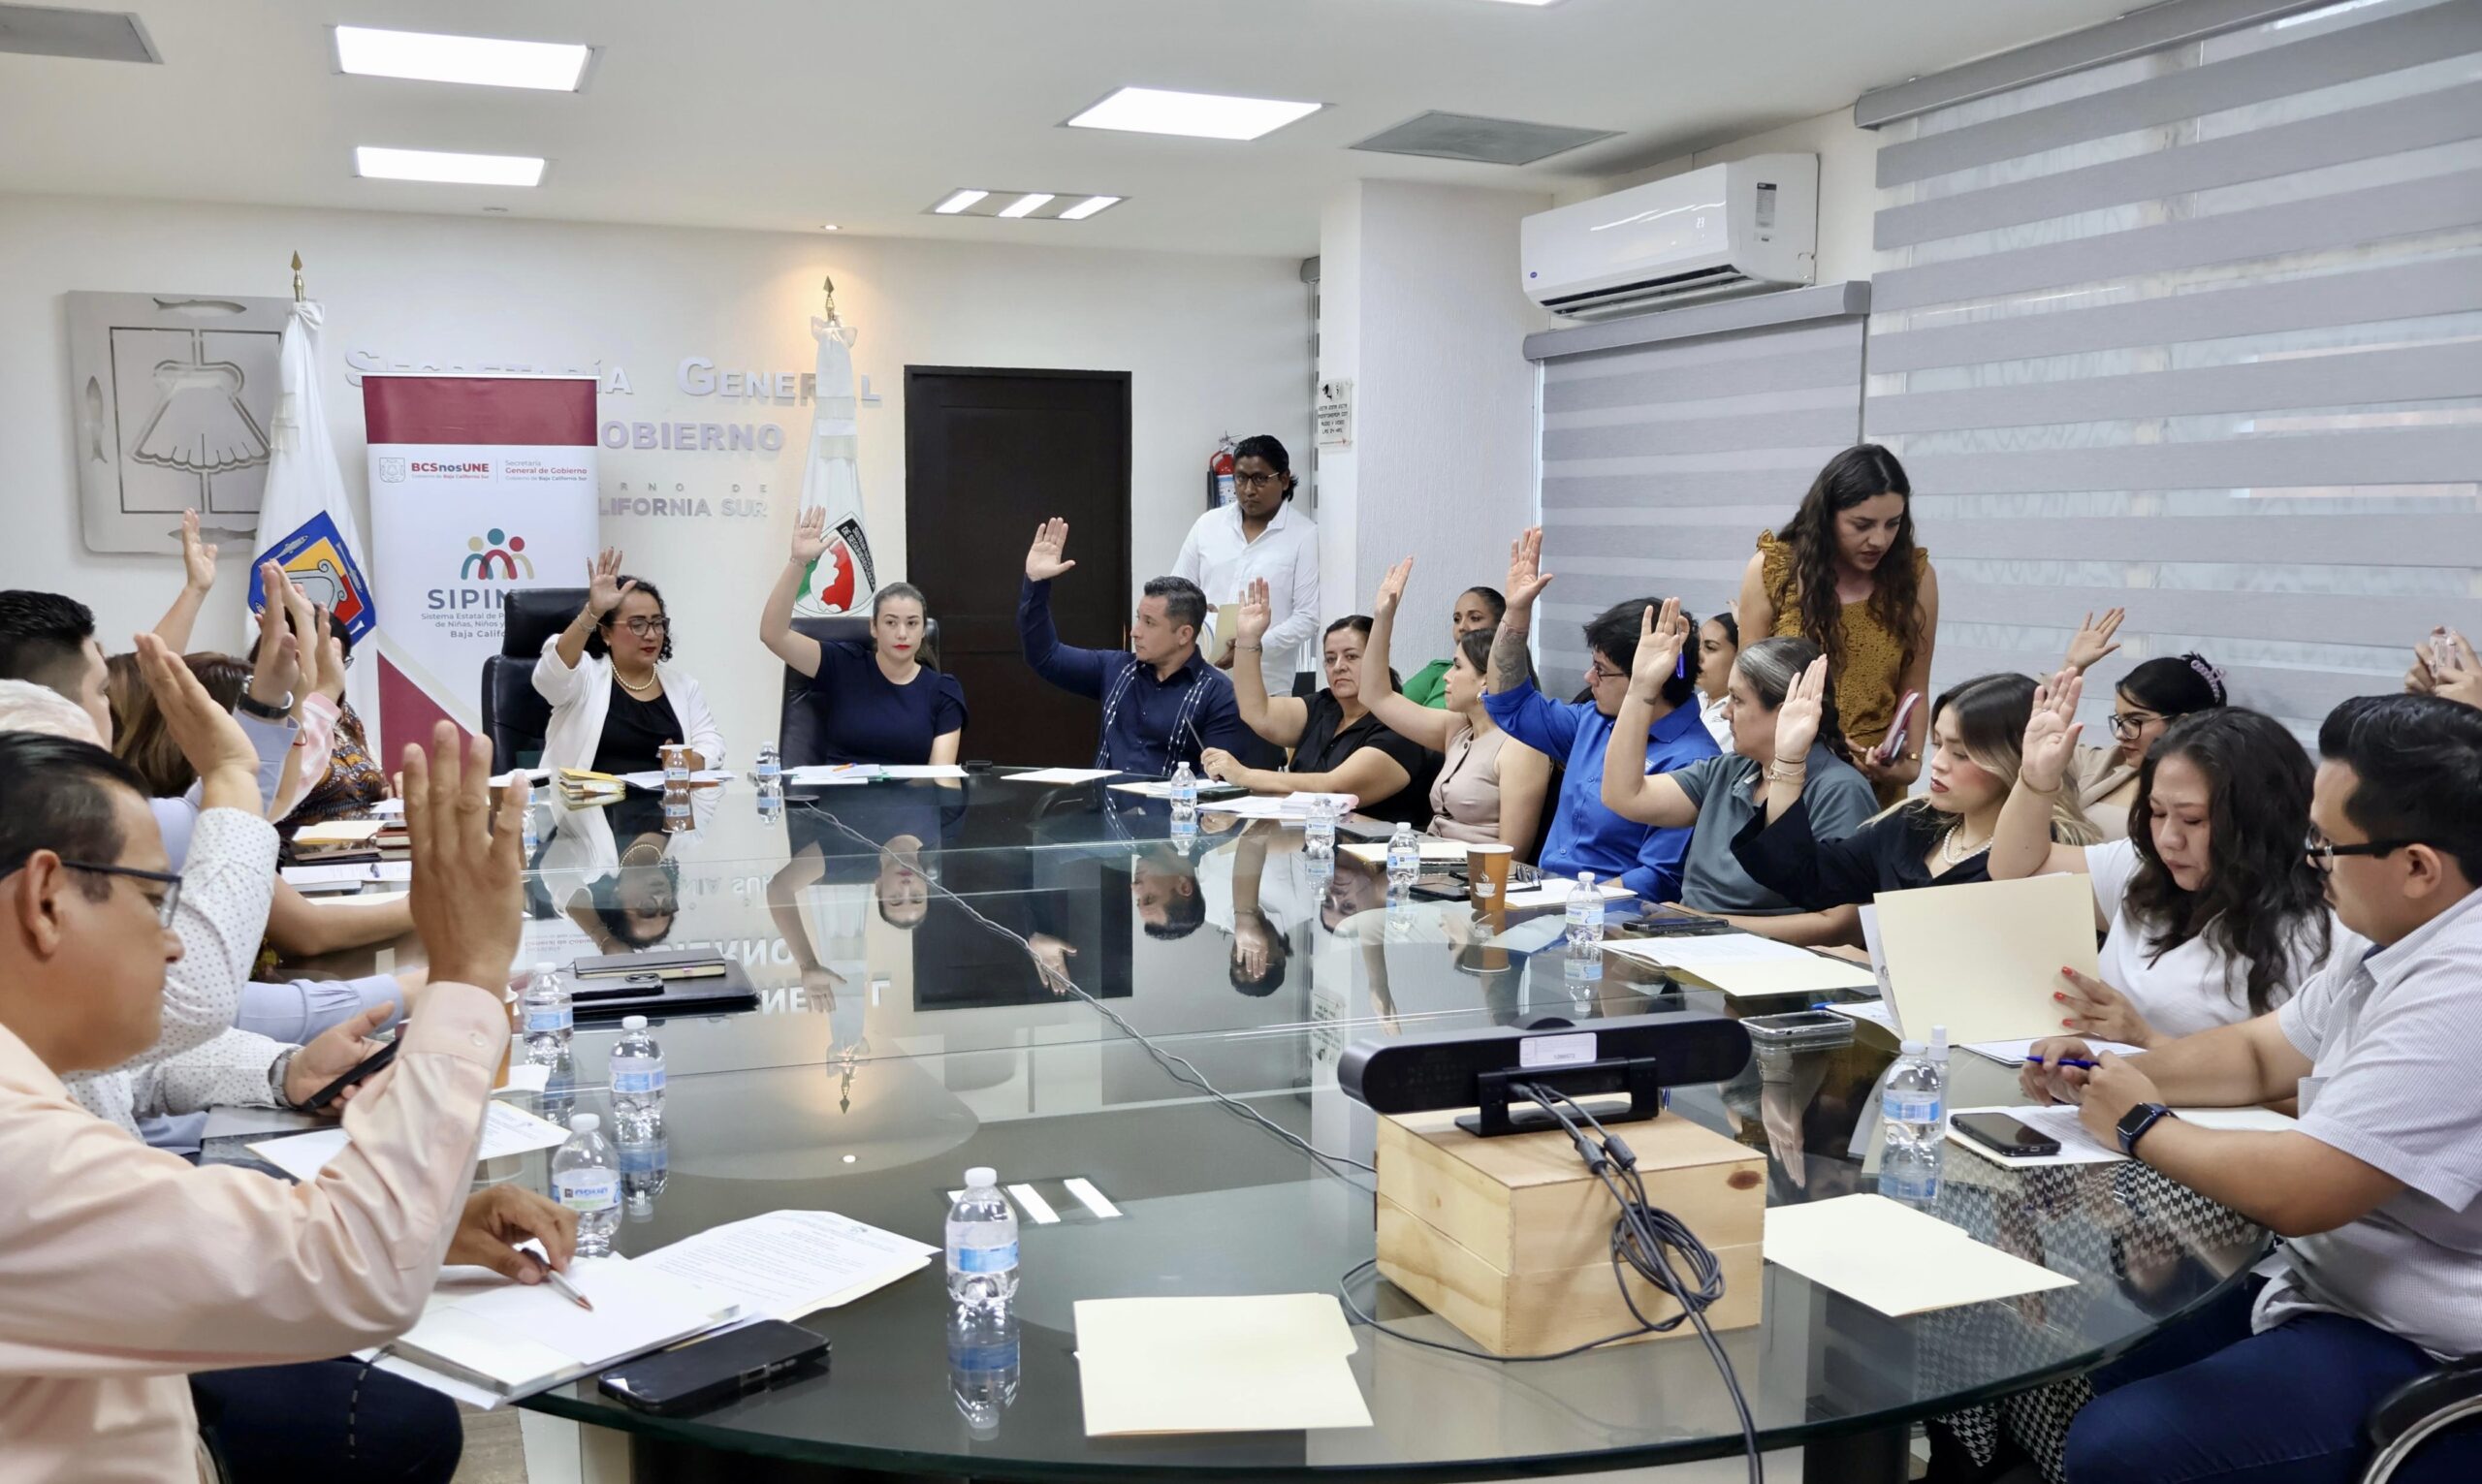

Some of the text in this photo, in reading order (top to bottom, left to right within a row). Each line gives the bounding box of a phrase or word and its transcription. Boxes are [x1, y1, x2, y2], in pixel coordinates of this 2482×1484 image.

[678, 356, 880, 401] GENERL
[601, 420, 784, 451] OBIERNO
[411, 463, 489, 472] BCSnosUNE
[598, 497, 768, 518] LIFORNIA SUR
[841, 526, 851, 536] DE
[428, 589, 506, 609] SIPIN
